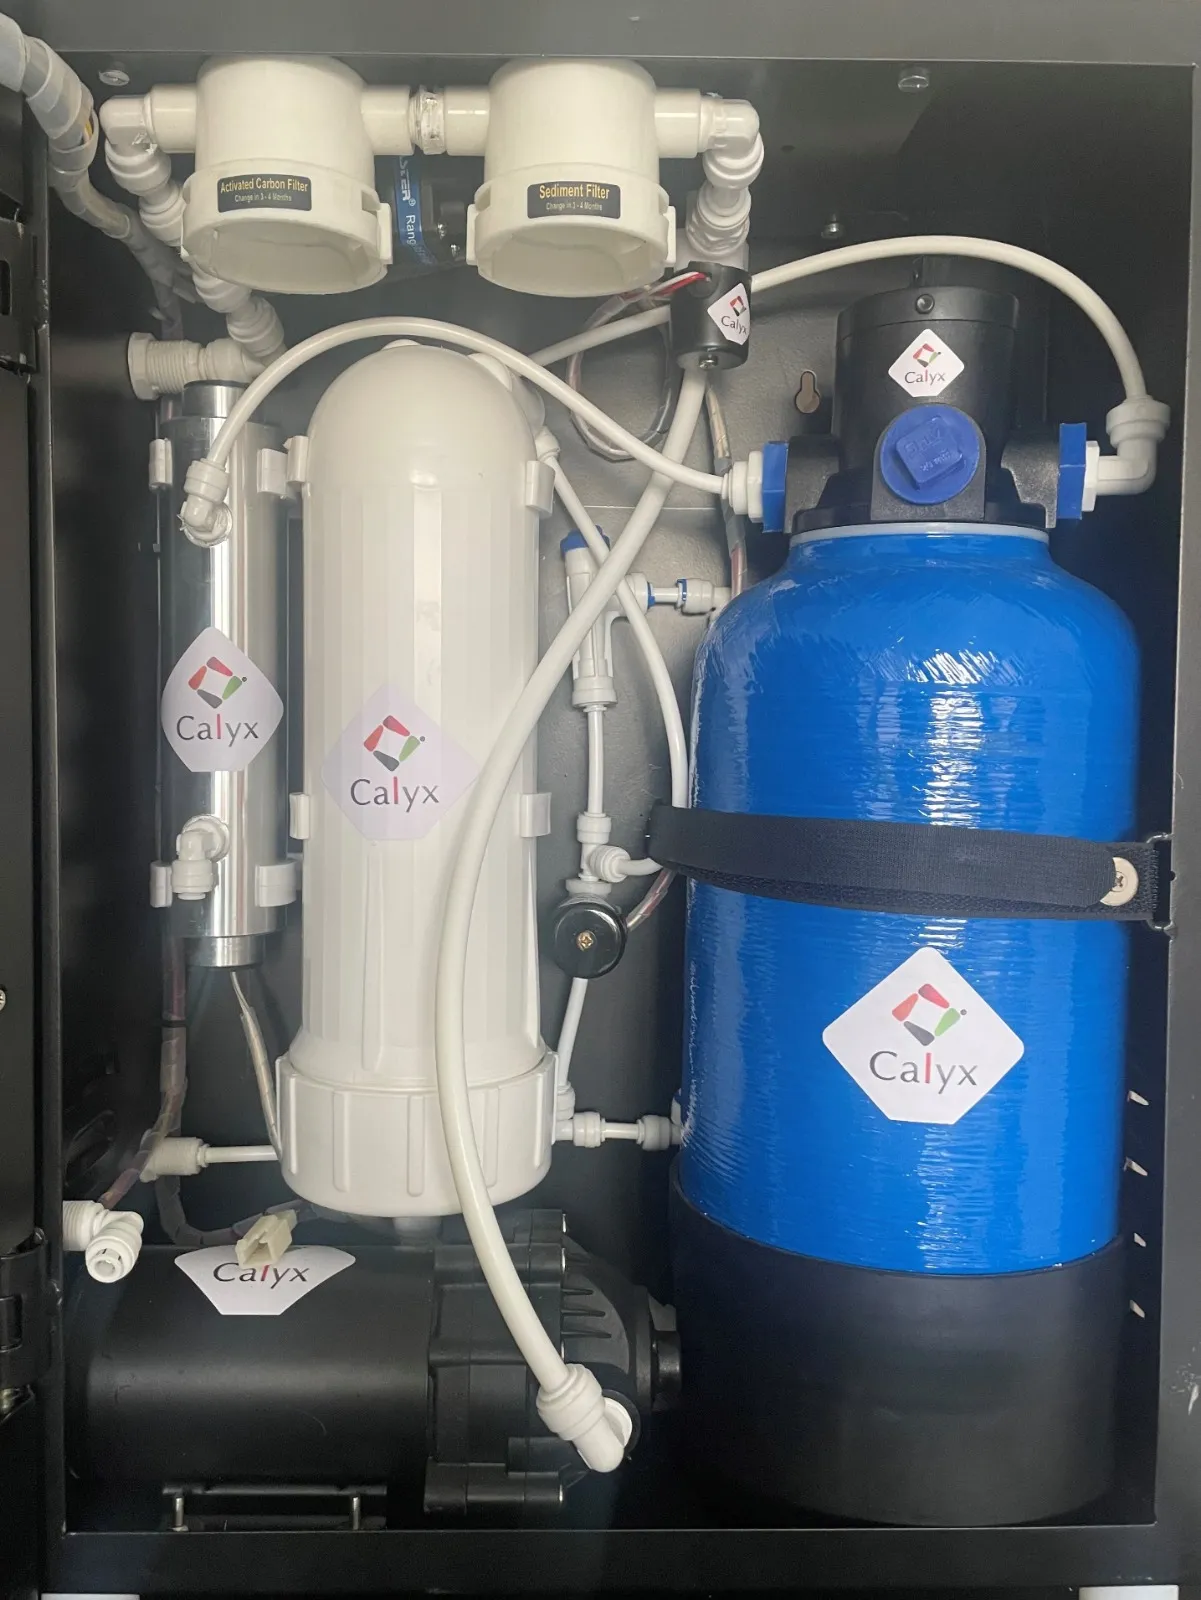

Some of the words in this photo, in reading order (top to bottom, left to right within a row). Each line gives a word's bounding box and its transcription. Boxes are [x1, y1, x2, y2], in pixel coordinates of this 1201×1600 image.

[220, 178, 254, 193] Activated
[255, 177, 285, 189] Carbon
[287, 178, 308, 192] Filter
[539, 183, 583, 199] Sediment
[586, 183, 610, 199] Filter
[234, 193, 253, 203] Change
[546, 202, 565, 211] Change
[721, 315, 747, 335] Calyx
[904, 369, 946, 386] Calyx
[176, 713, 259, 747] Calyx
[350, 776, 440, 813] Calyx
[869, 1051, 978, 1095] Calyx
[213, 1262, 310, 1289] Calyx
